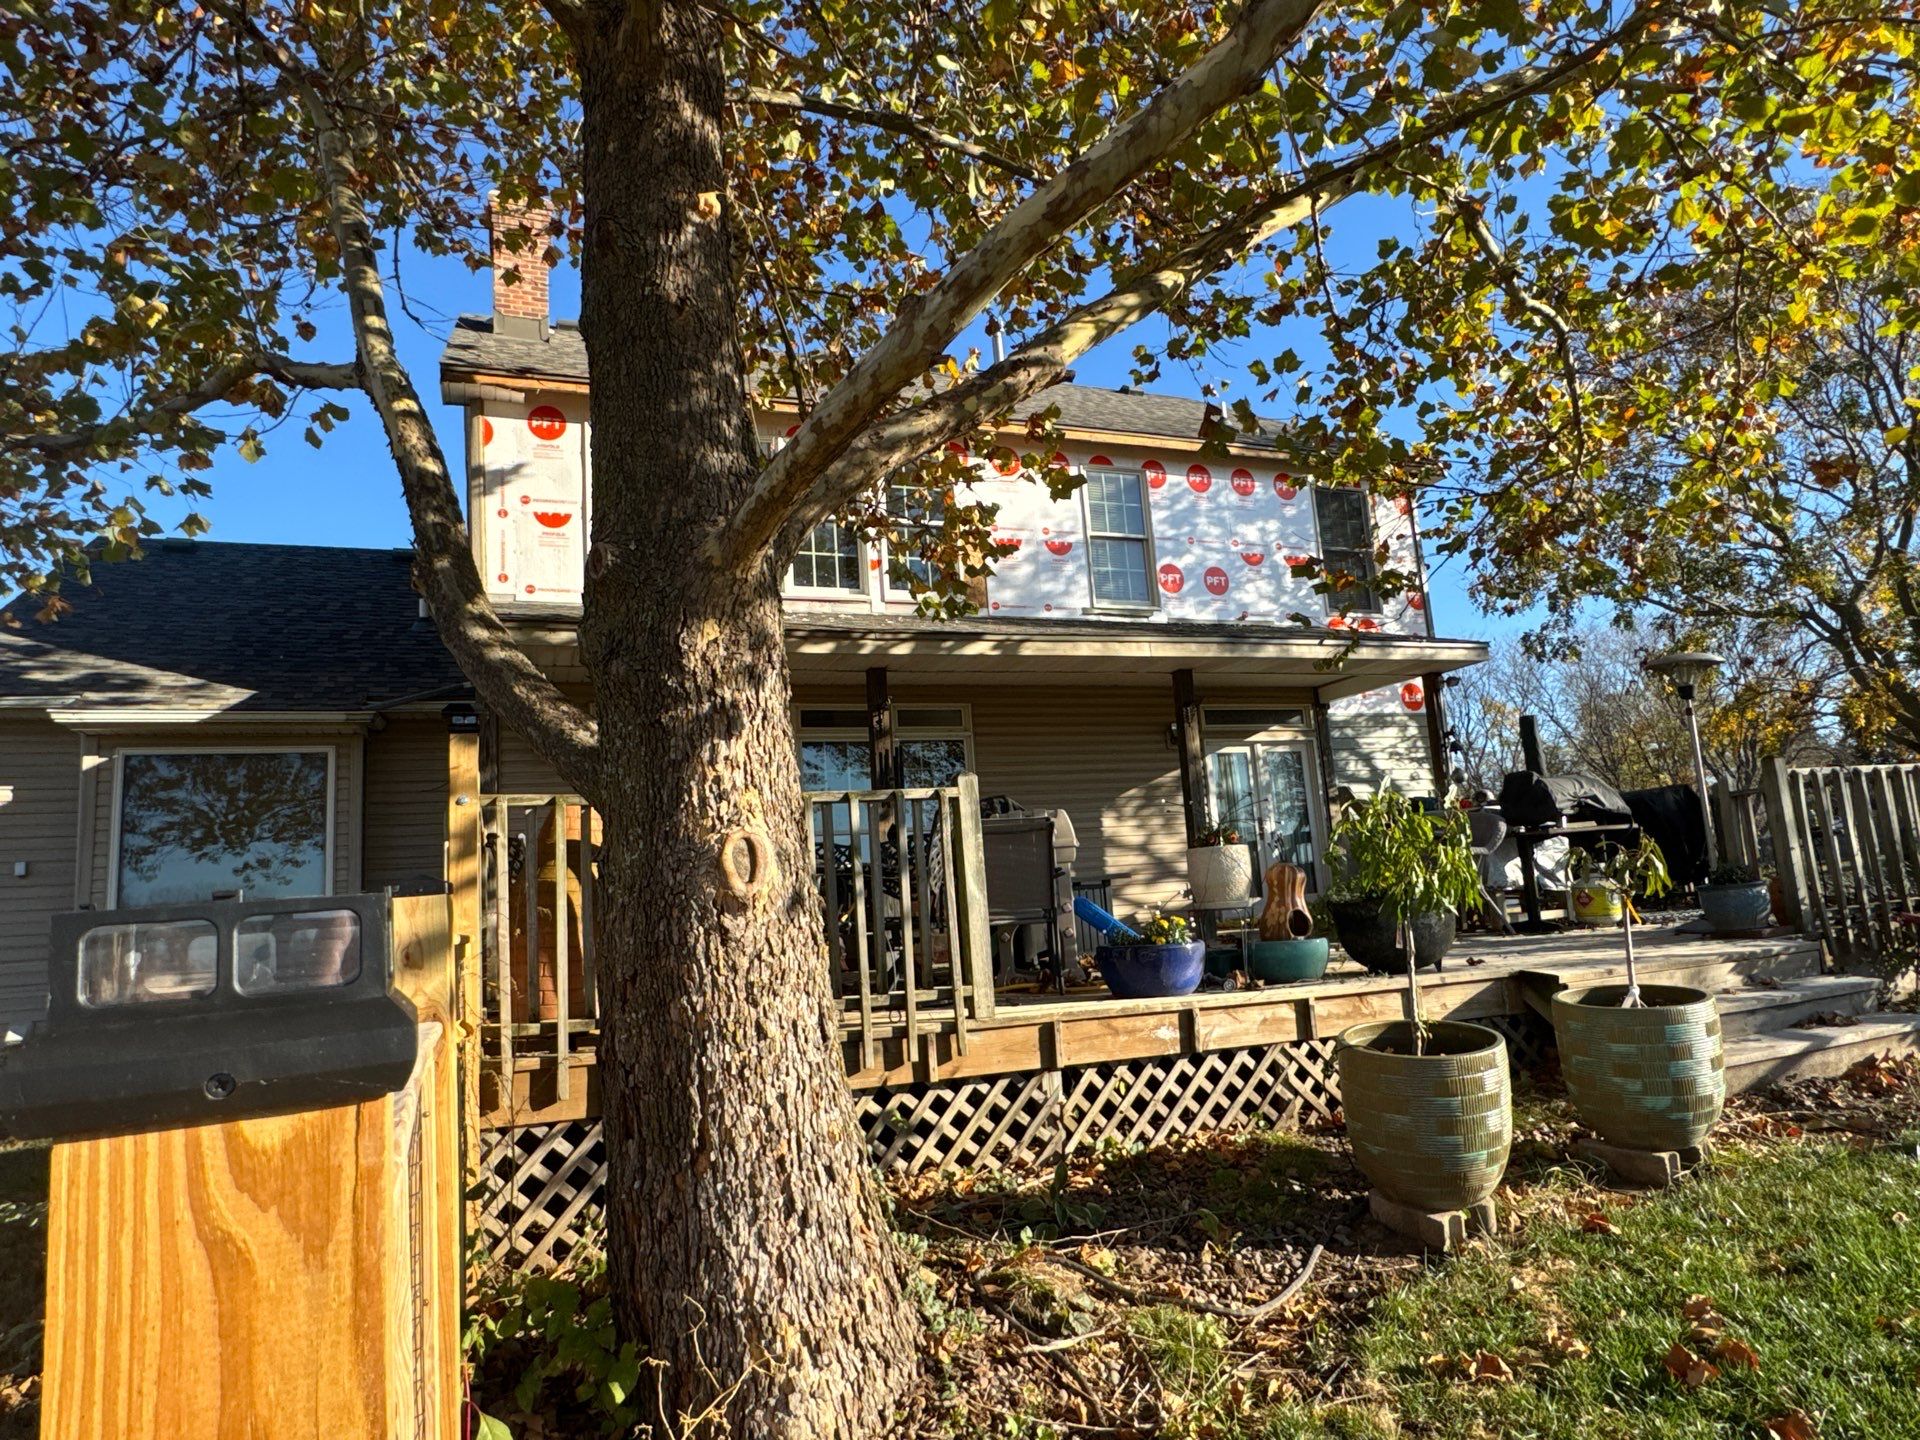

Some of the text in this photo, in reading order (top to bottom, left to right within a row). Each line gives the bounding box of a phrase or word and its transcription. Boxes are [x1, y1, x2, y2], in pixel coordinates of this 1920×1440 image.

[532, 417, 560, 429] PFT
[1189, 473, 1208, 483] PFT
[1233, 477, 1253, 487] PFT
[1160, 573, 1181, 584] PFT
[1206, 575, 1226, 586] PFT
[1404, 692, 1423, 703] PFT
